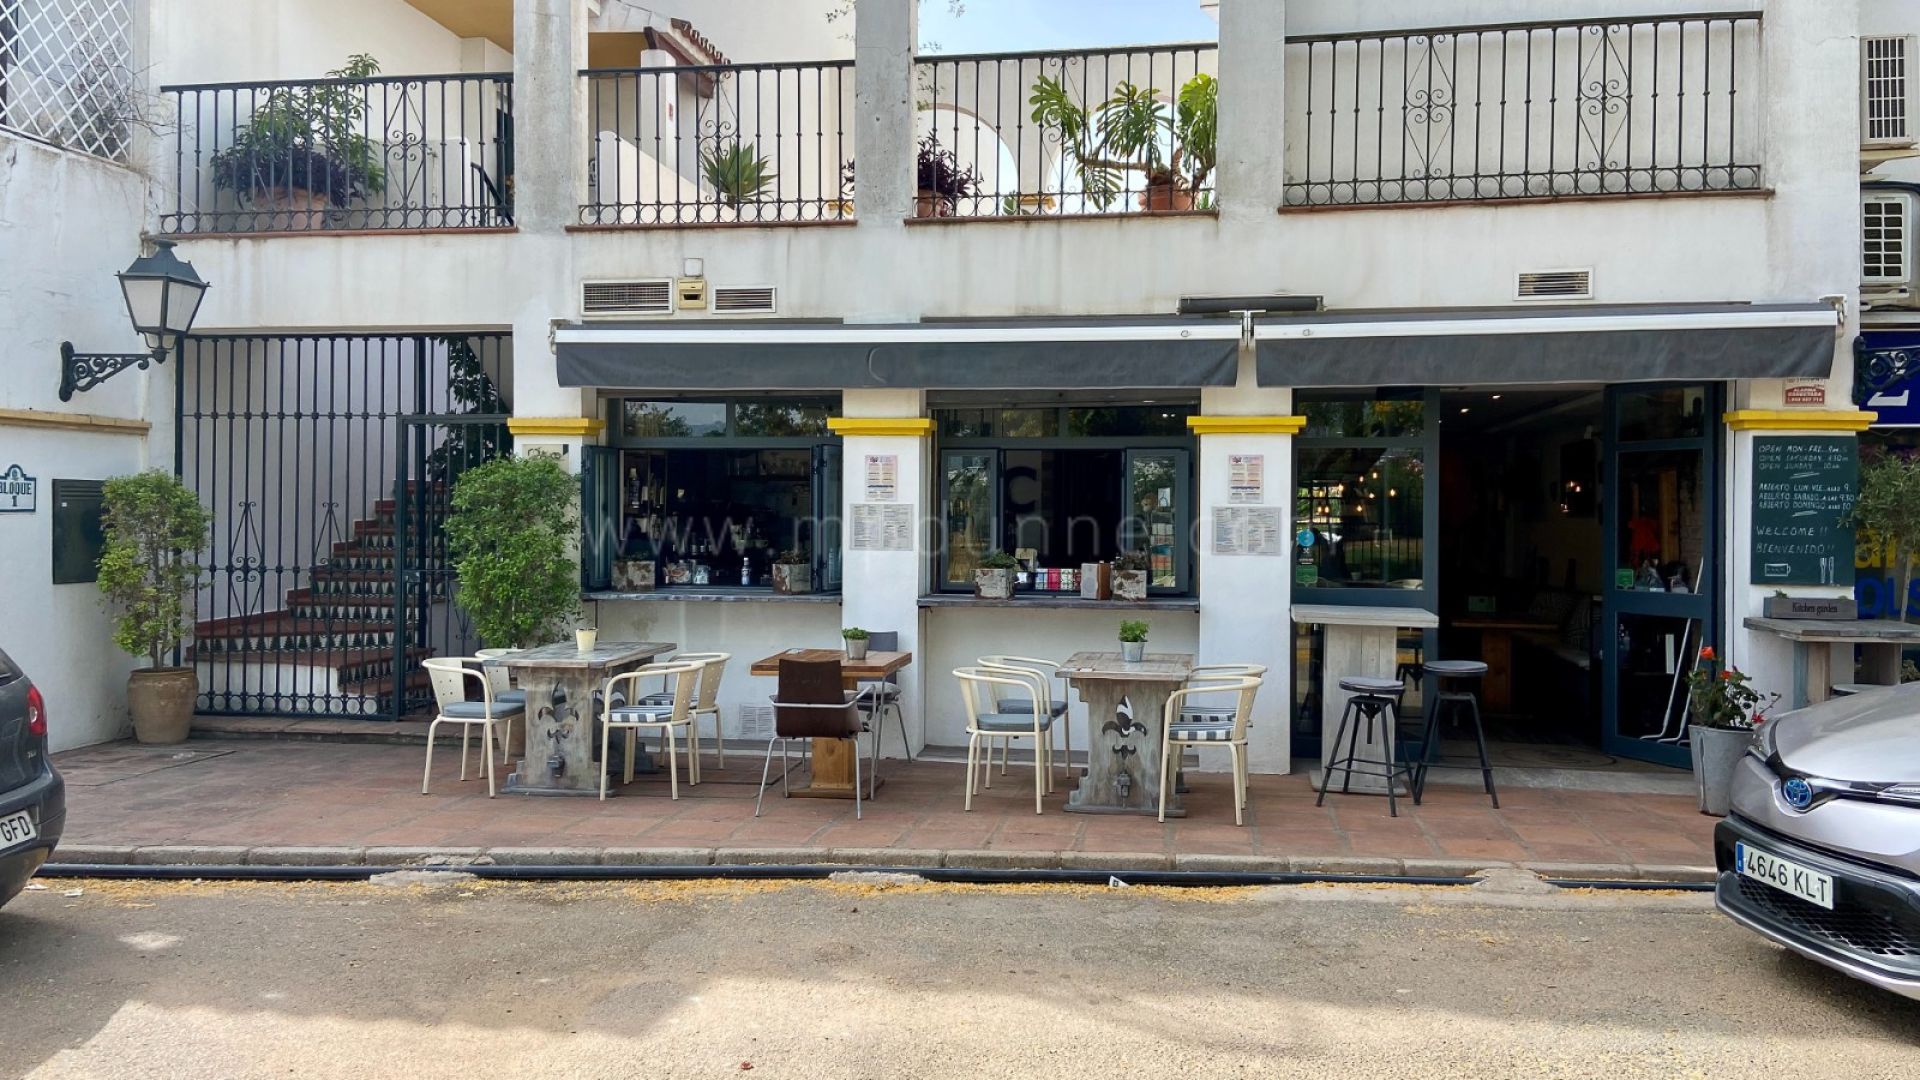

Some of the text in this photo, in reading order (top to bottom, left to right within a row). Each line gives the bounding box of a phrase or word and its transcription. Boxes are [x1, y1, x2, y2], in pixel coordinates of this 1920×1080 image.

[1759, 445, 1782, 453] OPEN
[1759, 483, 1790, 491] ABIERTO
[1759, 492, 1790, 500] ABIERTO
[1759, 501, 1790, 509] ABIERTO
[1792, 602, 1838, 616] Kitchen garden
[1747, 851, 1828, 902] 4646 KLT
